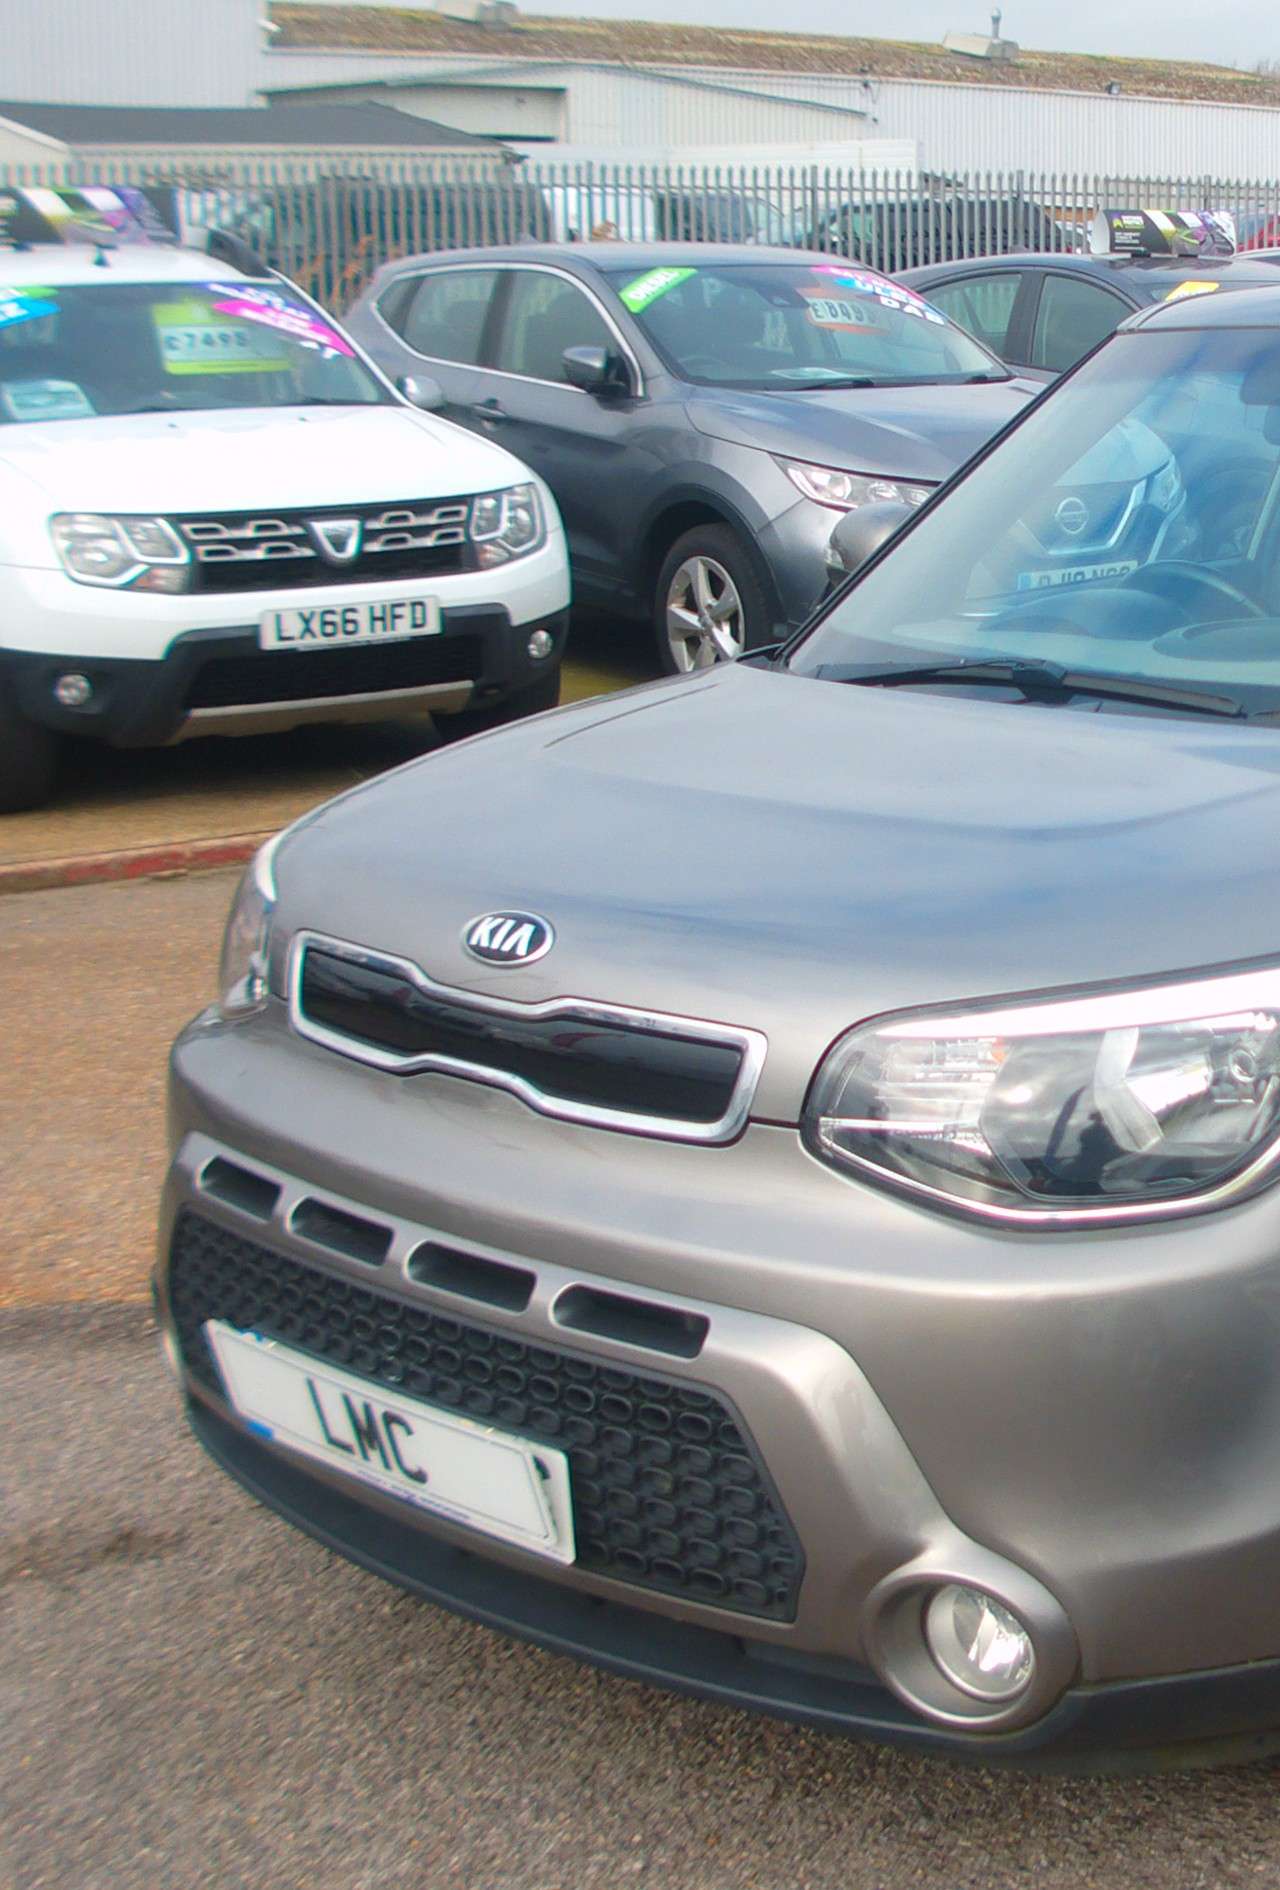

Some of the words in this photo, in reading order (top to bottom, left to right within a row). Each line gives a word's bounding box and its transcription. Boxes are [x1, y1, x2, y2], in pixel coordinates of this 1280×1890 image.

[275, 607, 359, 642] LX66
[369, 600, 427, 633] HFD
[469, 916, 537, 956] KIA
[305, 1376, 429, 1485] LMC
